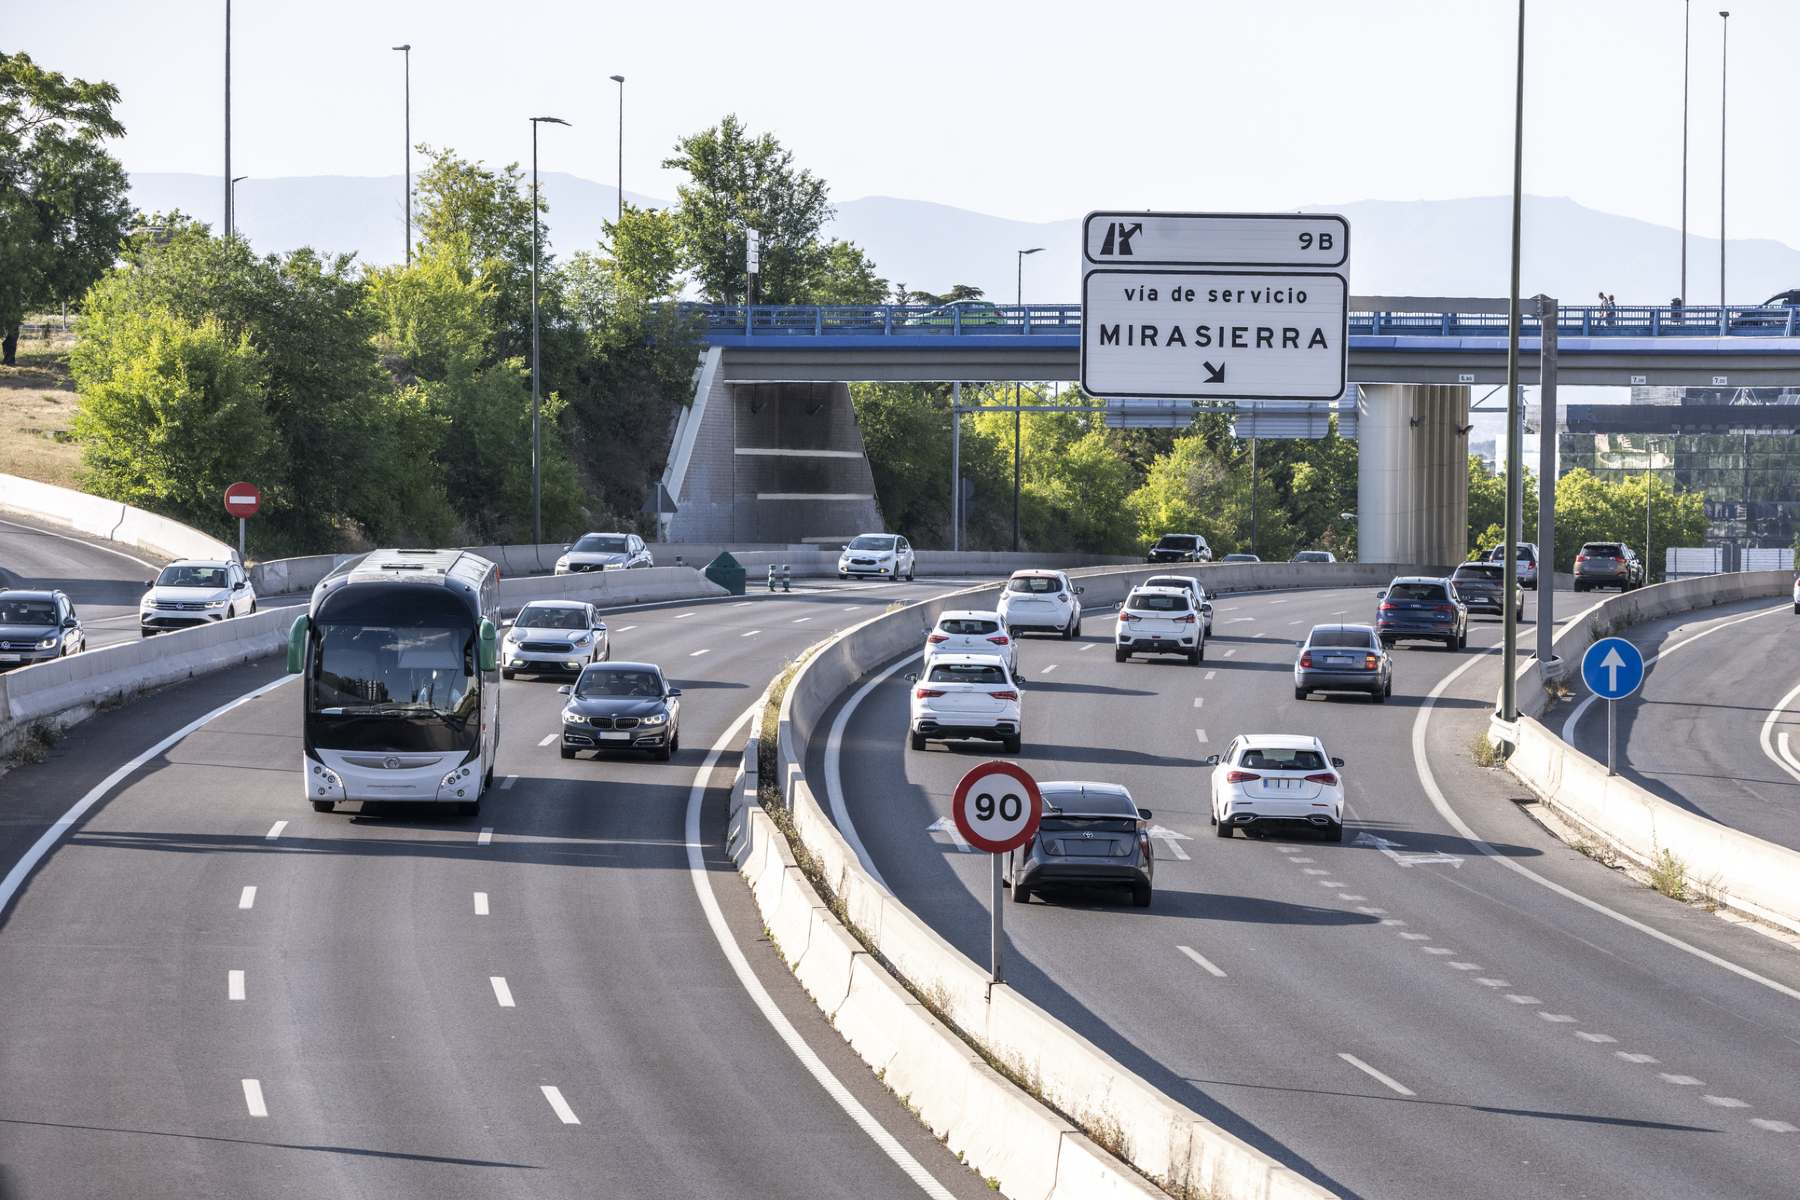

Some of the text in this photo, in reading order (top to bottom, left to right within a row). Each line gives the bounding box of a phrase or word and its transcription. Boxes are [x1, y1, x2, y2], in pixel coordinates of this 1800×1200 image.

[1299, 233, 1333, 250] 9B
[1124, 285, 1307, 304] vía de servicio
[1100, 324, 1328, 349] MIRASIERRA
[975, 793, 1022, 822] 90
